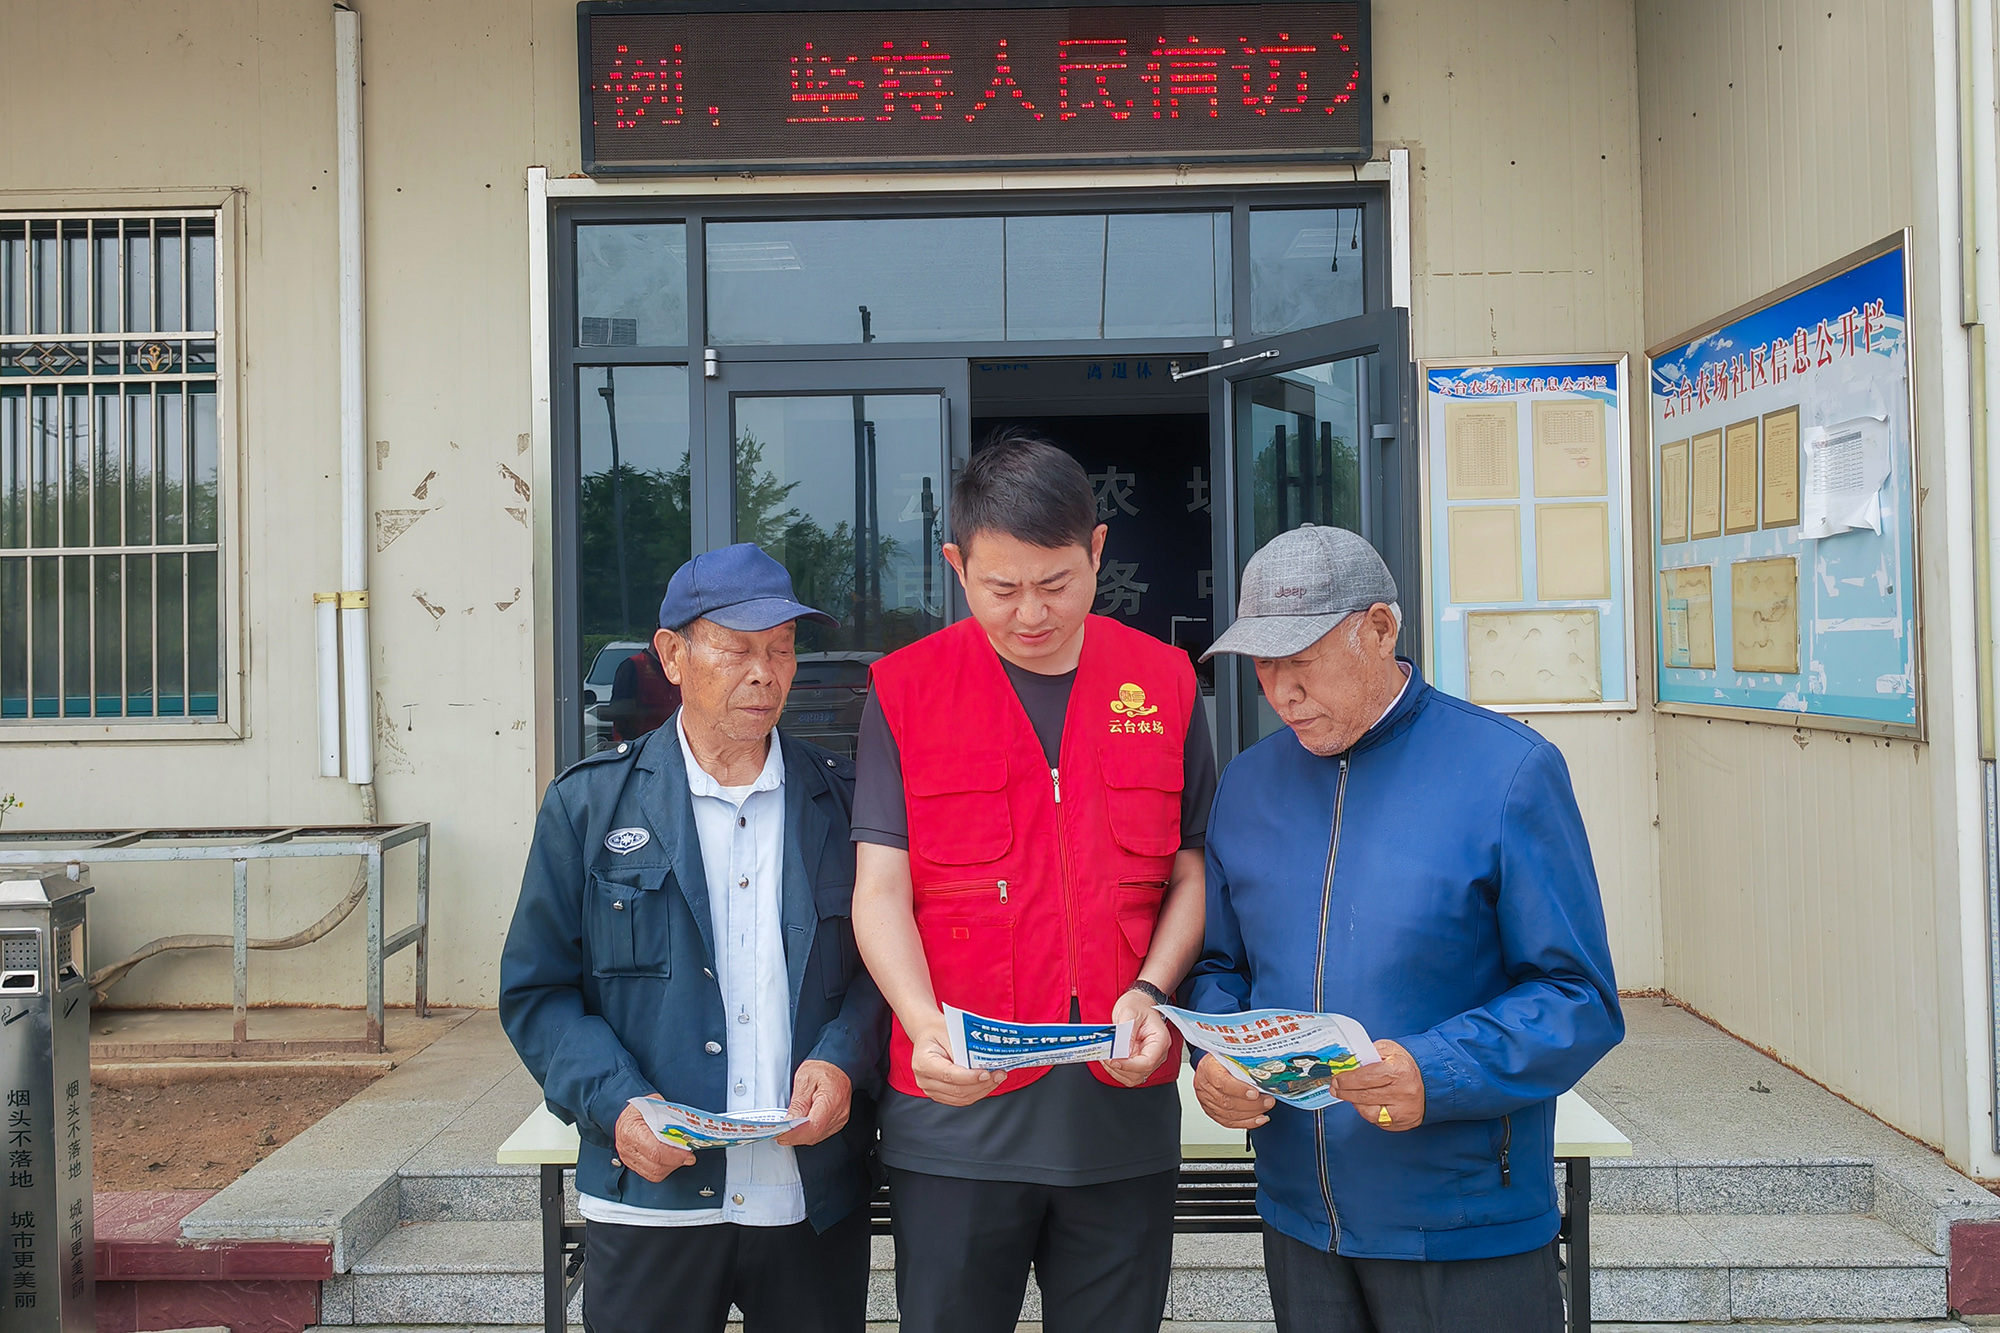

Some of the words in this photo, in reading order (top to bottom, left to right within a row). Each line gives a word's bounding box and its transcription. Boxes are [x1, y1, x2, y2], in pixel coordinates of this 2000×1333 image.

[1438, 375, 1608, 395] 云台农场社区信息公示栏
[1662, 298, 1885, 420] 云台农场社区信息公开栏
[1275, 586, 1307, 599] Jeep
[1108, 719, 1164, 735] 云台农场
[7, 1088, 35, 1189] 烟头不落地
[66, 1079, 83, 1181] 烟头不落地
[10, 1210, 37, 1309] 城市更美丽
[69, 1197, 85, 1300] 城市更美丽
